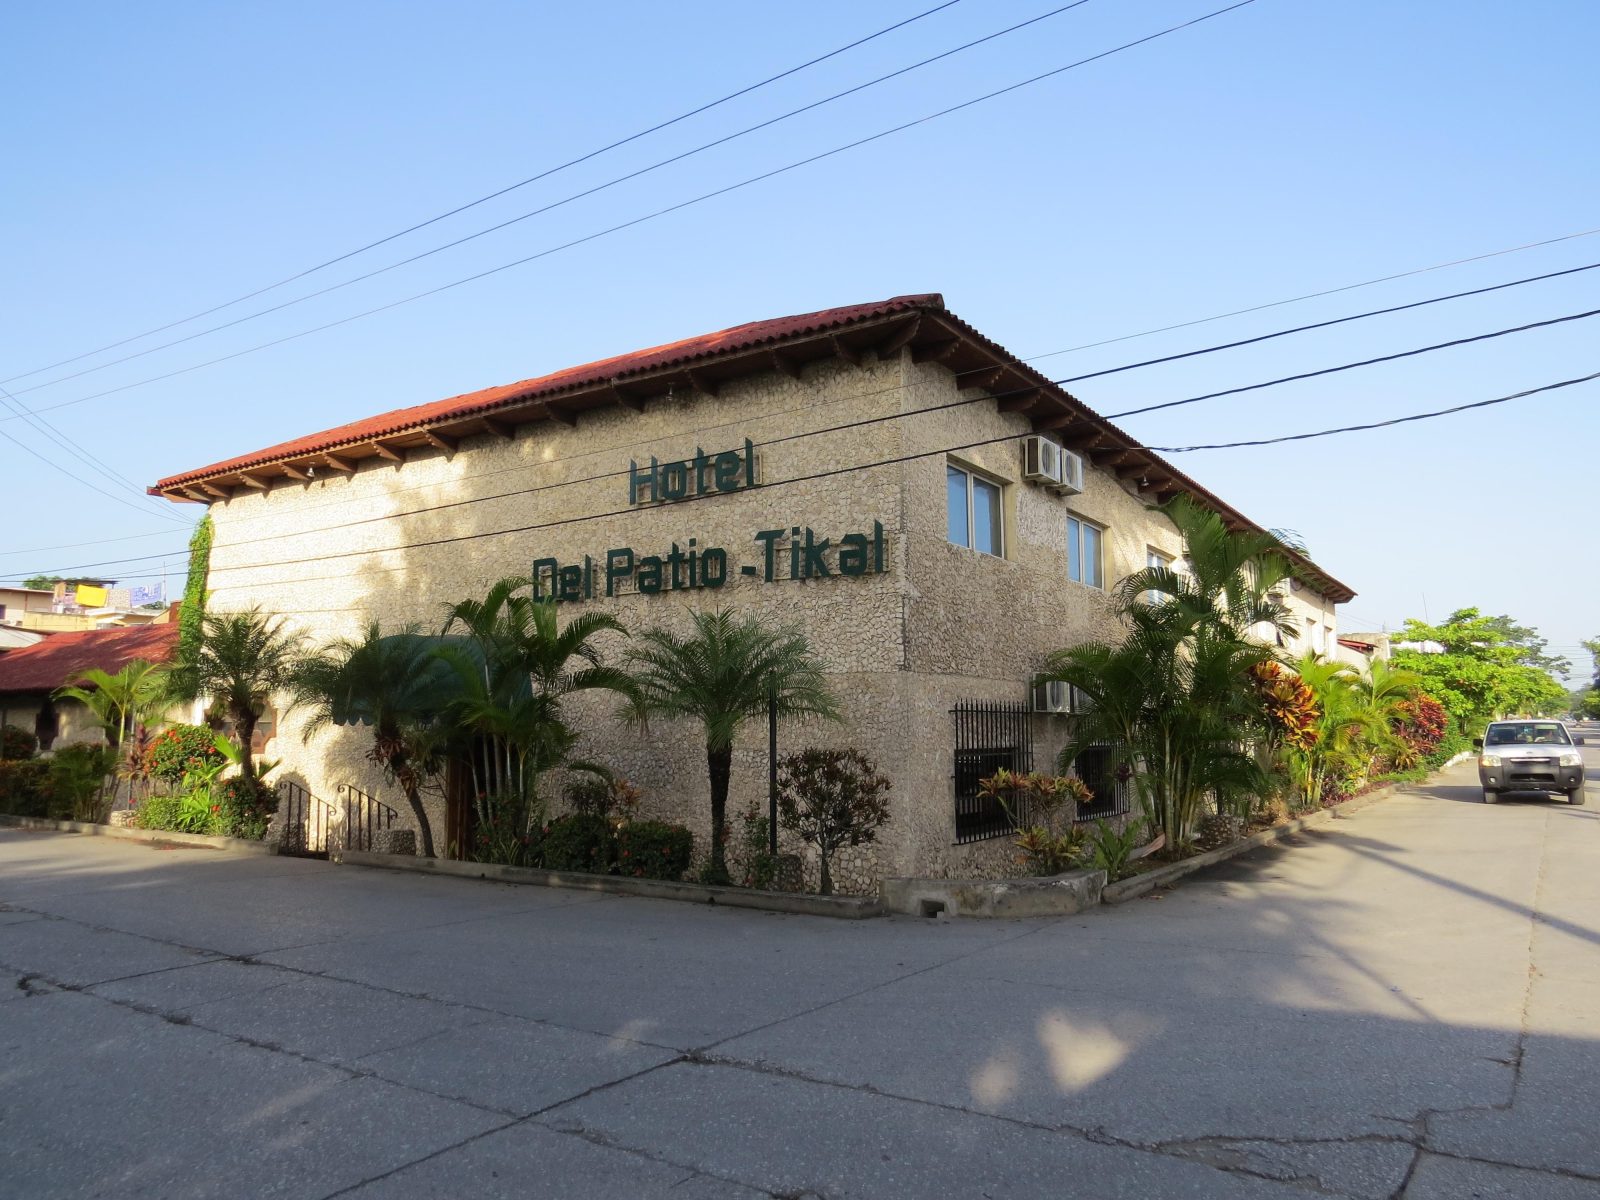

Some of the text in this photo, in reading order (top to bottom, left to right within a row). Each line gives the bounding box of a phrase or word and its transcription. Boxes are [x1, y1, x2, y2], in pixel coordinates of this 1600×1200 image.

[630, 437, 755, 505] Hotel
[533, 554, 592, 603] Del
[606, 538, 727, 598] Patio
